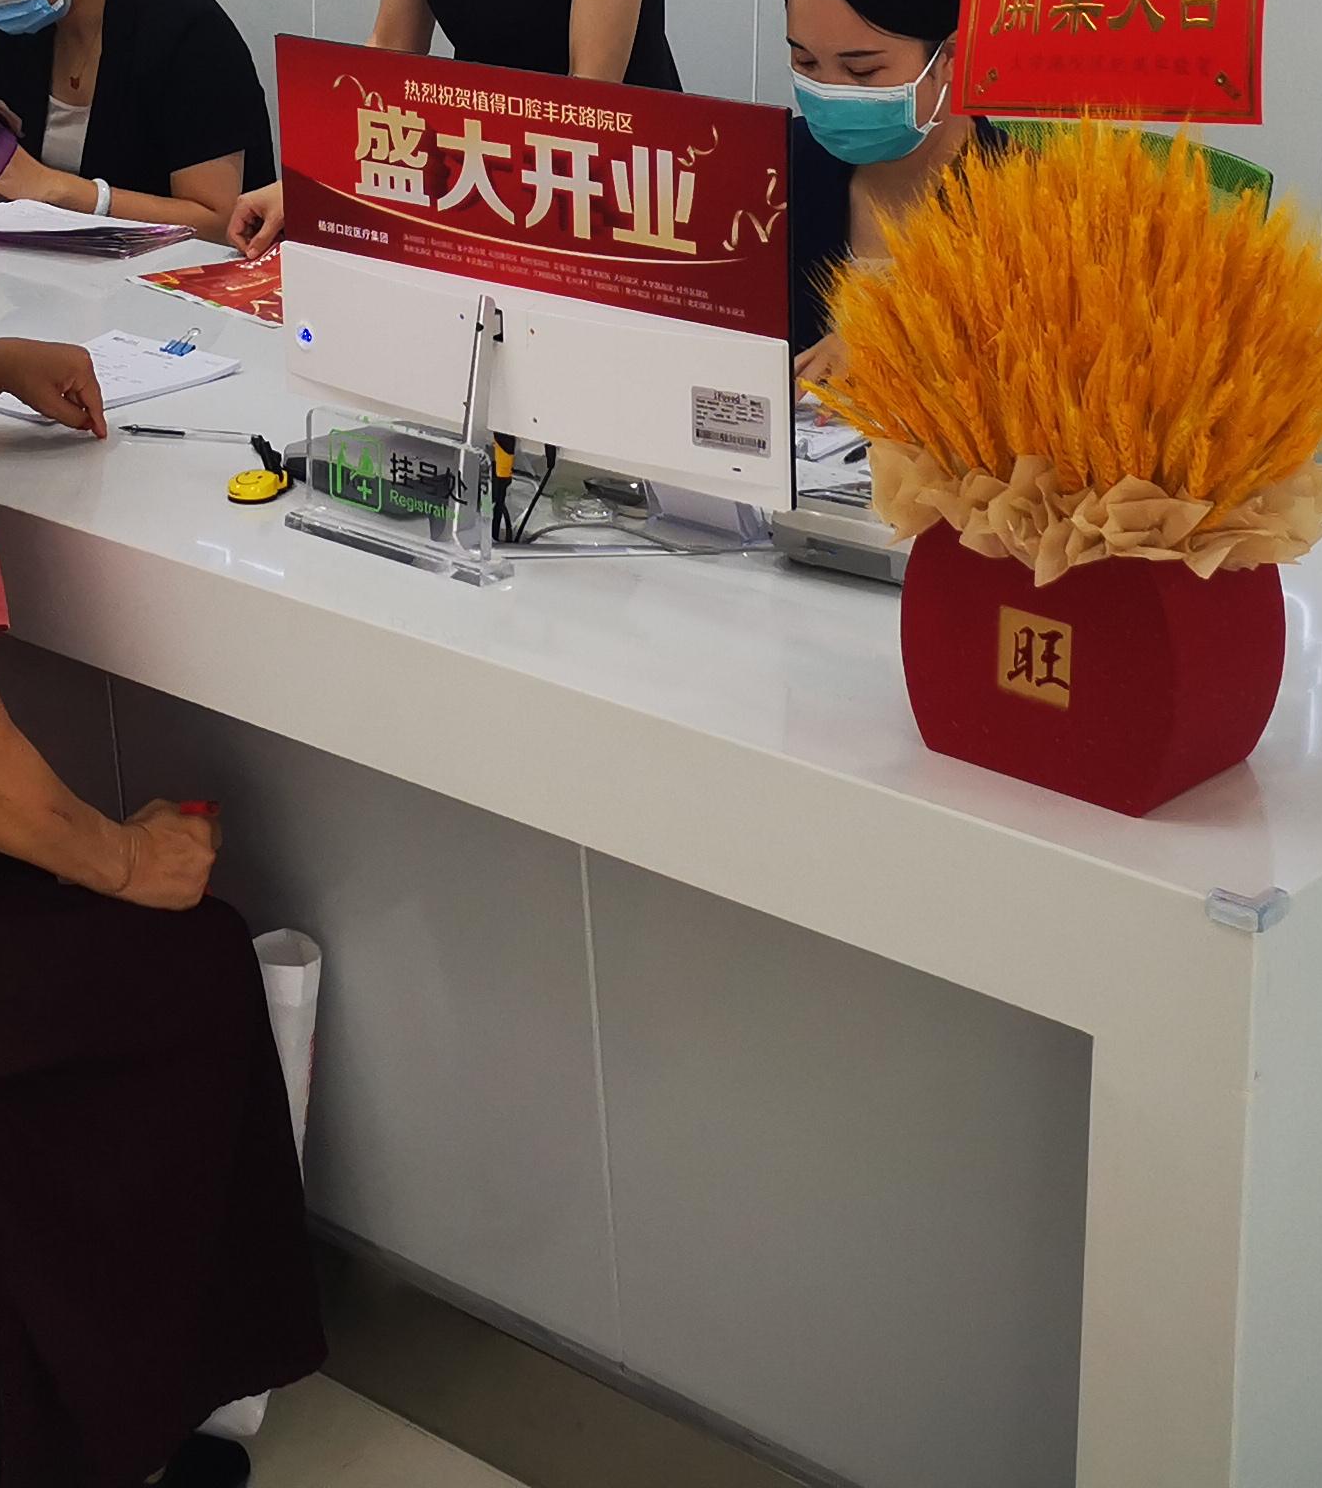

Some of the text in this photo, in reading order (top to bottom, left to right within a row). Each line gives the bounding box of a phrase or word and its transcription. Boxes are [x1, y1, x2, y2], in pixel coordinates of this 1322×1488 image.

[403, 78, 635, 135] 热烈祝贺植得口腔丰庆路院区
[353, 105, 698, 255] 盛大开业
[389, 452, 469, 506] 挂号处
[1005, 623, 1071, 692] 旺
